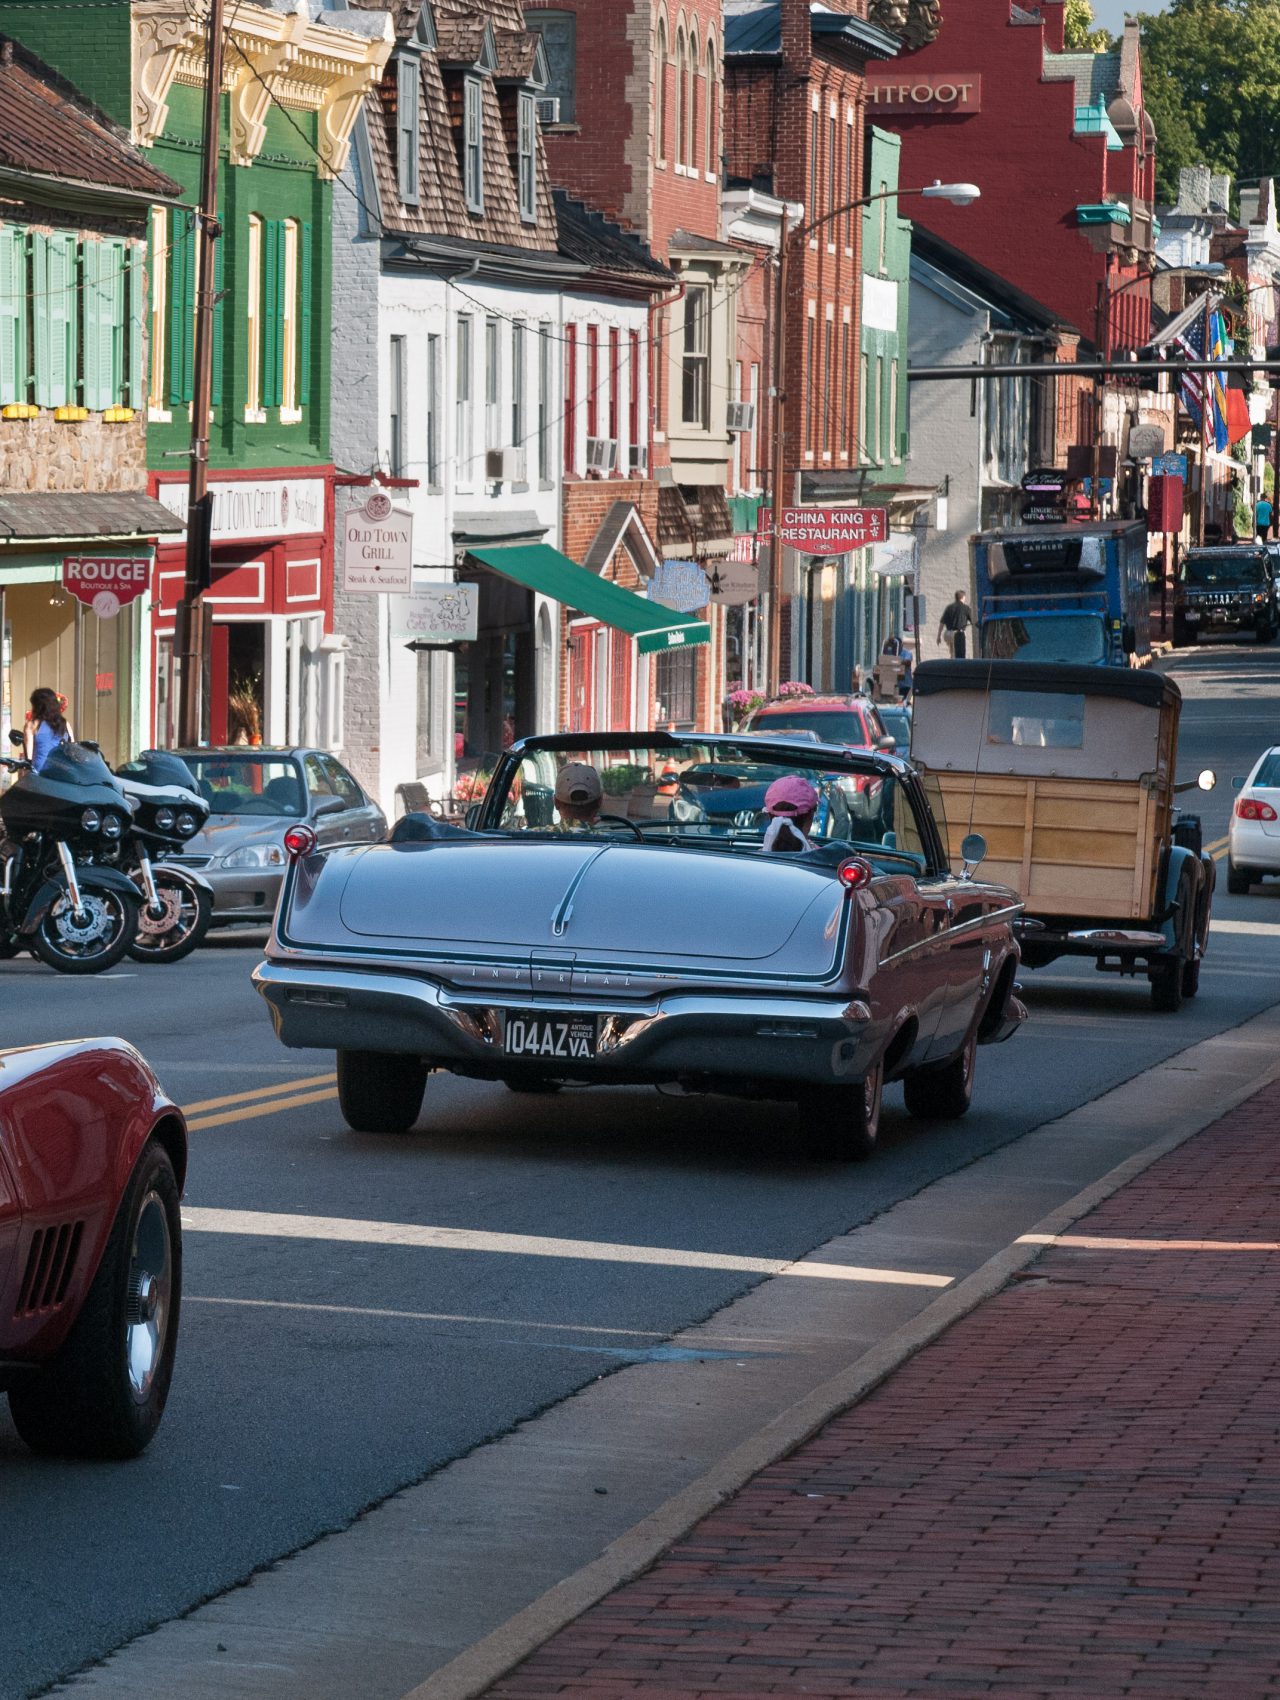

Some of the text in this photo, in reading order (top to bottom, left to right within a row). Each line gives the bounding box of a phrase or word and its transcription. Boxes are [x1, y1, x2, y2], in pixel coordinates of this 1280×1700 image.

[785, 513, 825, 524] CHINA
[831, 513, 864, 524] KING
[349, 528, 408, 543] OLD TOWN
[781, 528, 867, 540] RESTAURANT
[362, 545, 394, 559] GRILL
[67, 563, 145, 580] ROUGE
[348, 575, 407, 584] Steak & Seafood
[441, 620, 467, 633] Dogs
[472, 968, 630, 986] IMPERIAL
[571, 1024, 594, 1032] ANTIQUE
[505, 1020, 569, 1057] 104AZ
[570, 1031, 593, 1039] VEHICLE
[569, 1038, 595, 1058] VA.
